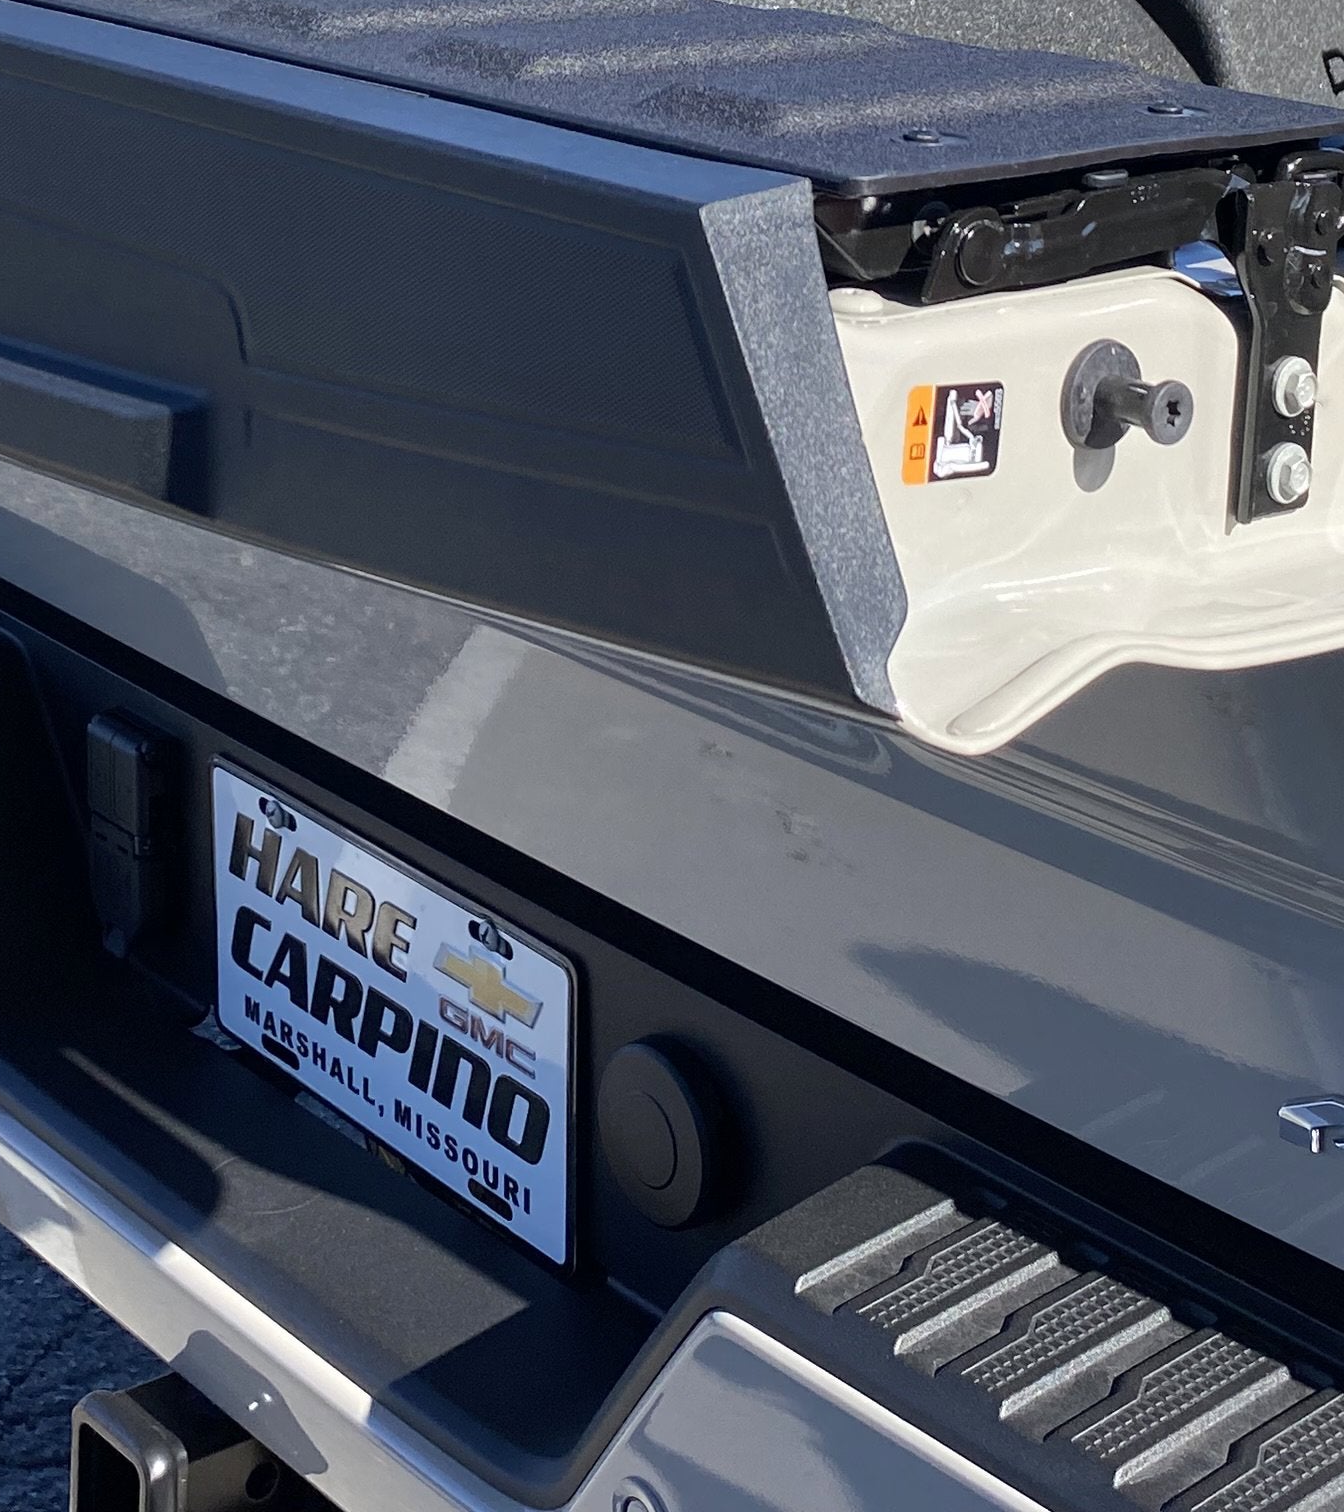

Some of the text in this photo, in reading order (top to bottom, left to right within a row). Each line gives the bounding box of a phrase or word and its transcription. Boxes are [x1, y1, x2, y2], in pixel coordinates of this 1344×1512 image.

[229, 811, 418, 984] HARE
[230, 905, 551, 1166] CARPINO
[244, 993, 532, 1216] MARSHALL, MISSOURI
[438, 992, 537, 1081] GMC
